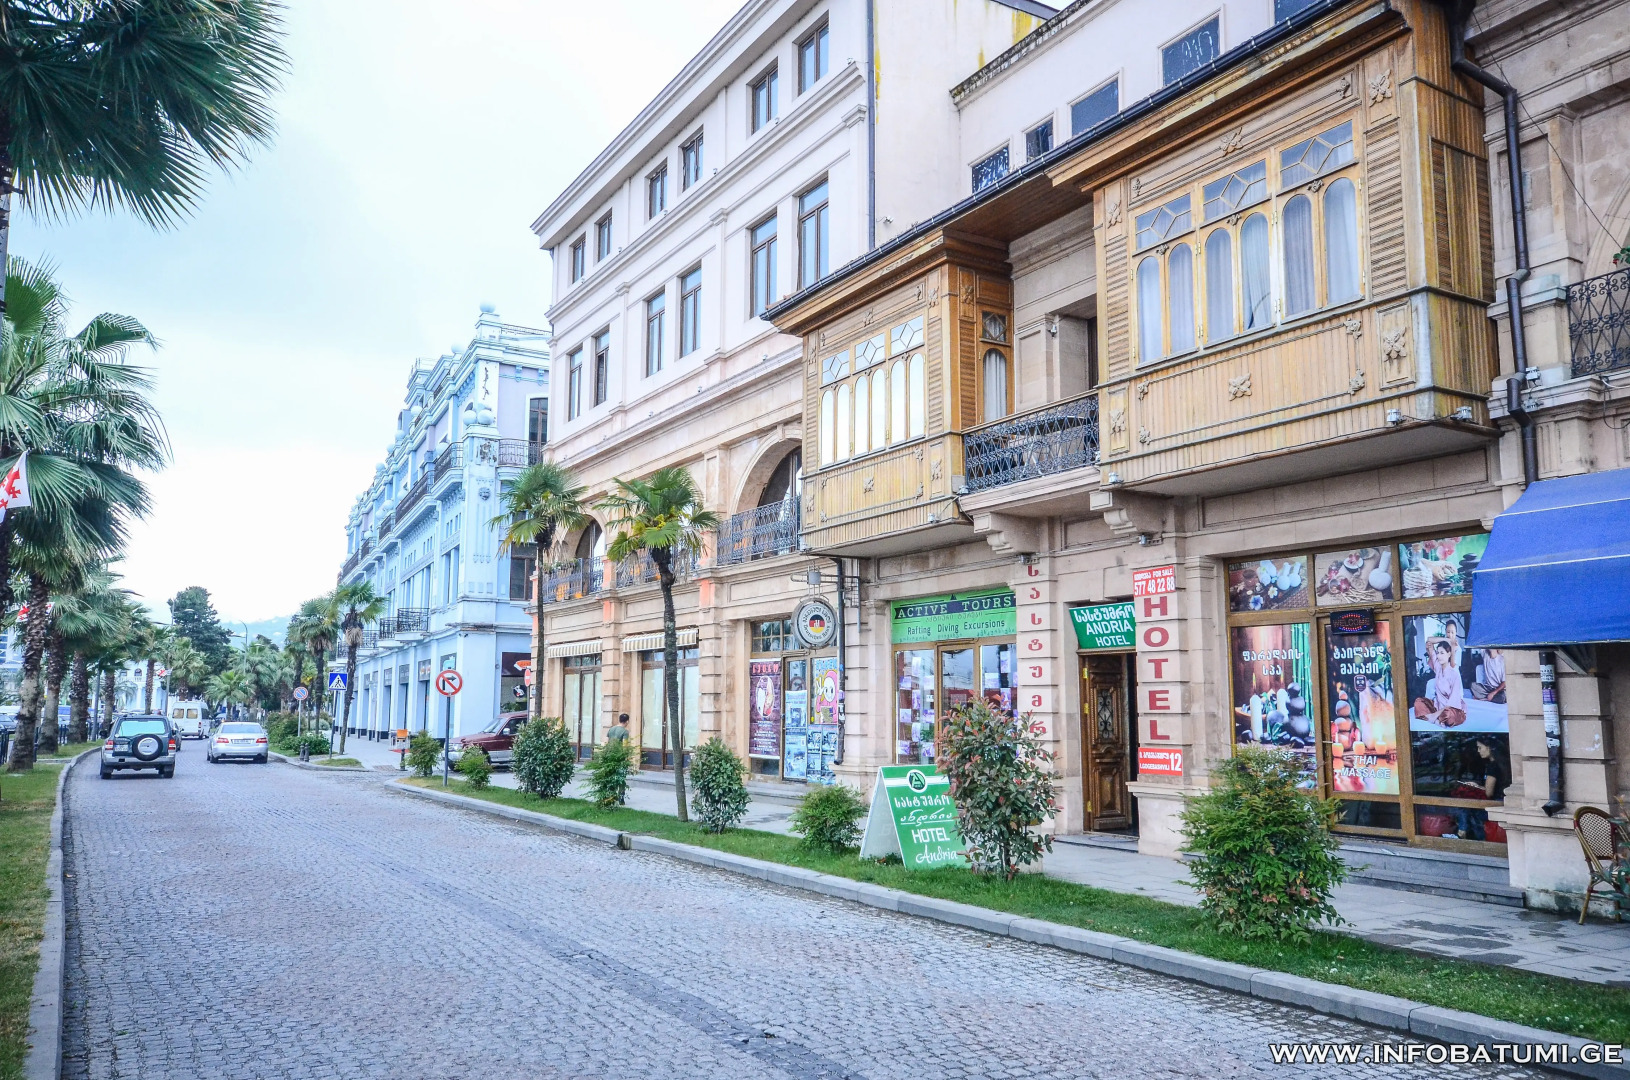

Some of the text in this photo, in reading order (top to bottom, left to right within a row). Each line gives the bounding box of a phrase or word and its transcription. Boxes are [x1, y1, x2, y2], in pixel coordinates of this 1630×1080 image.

[1152, 568, 1173, 578] FOR SALE
[1134, 576, 1175, 595] 577 48 22 88
[897, 596, 1012, 618] ACTIVE TOURS
[1073, 604, 1136, 623] სასტუმრო
[907, 626, 931, 636] Rafting
[937, 623, 959, 634] Diving
[963, 620, 1005, 630] Excursions
[1086, 619, 1134, 636] ANDRIA
[1095, 635, 1131, 647] HOTEL
[1333, 645, 1384, 659] ტაილანდ
[1143, 595, 1170, 741] HOTEL
[1262, 664, 1282, 676] სპა
[1340, 662, 1379, 675] მასაჟი
[1169, 752, 1182, 771] 12
[1353, 755, 1377, 766] THAI
[1340, 767, 1391, 779] MASSAGE
[893, 794, 951, 808] სასტუმრო
[900, 807, 953, 827] ანდრია
[911, 827, 950, 844] HOTEL
[915, 844, 959, 864] Andria
